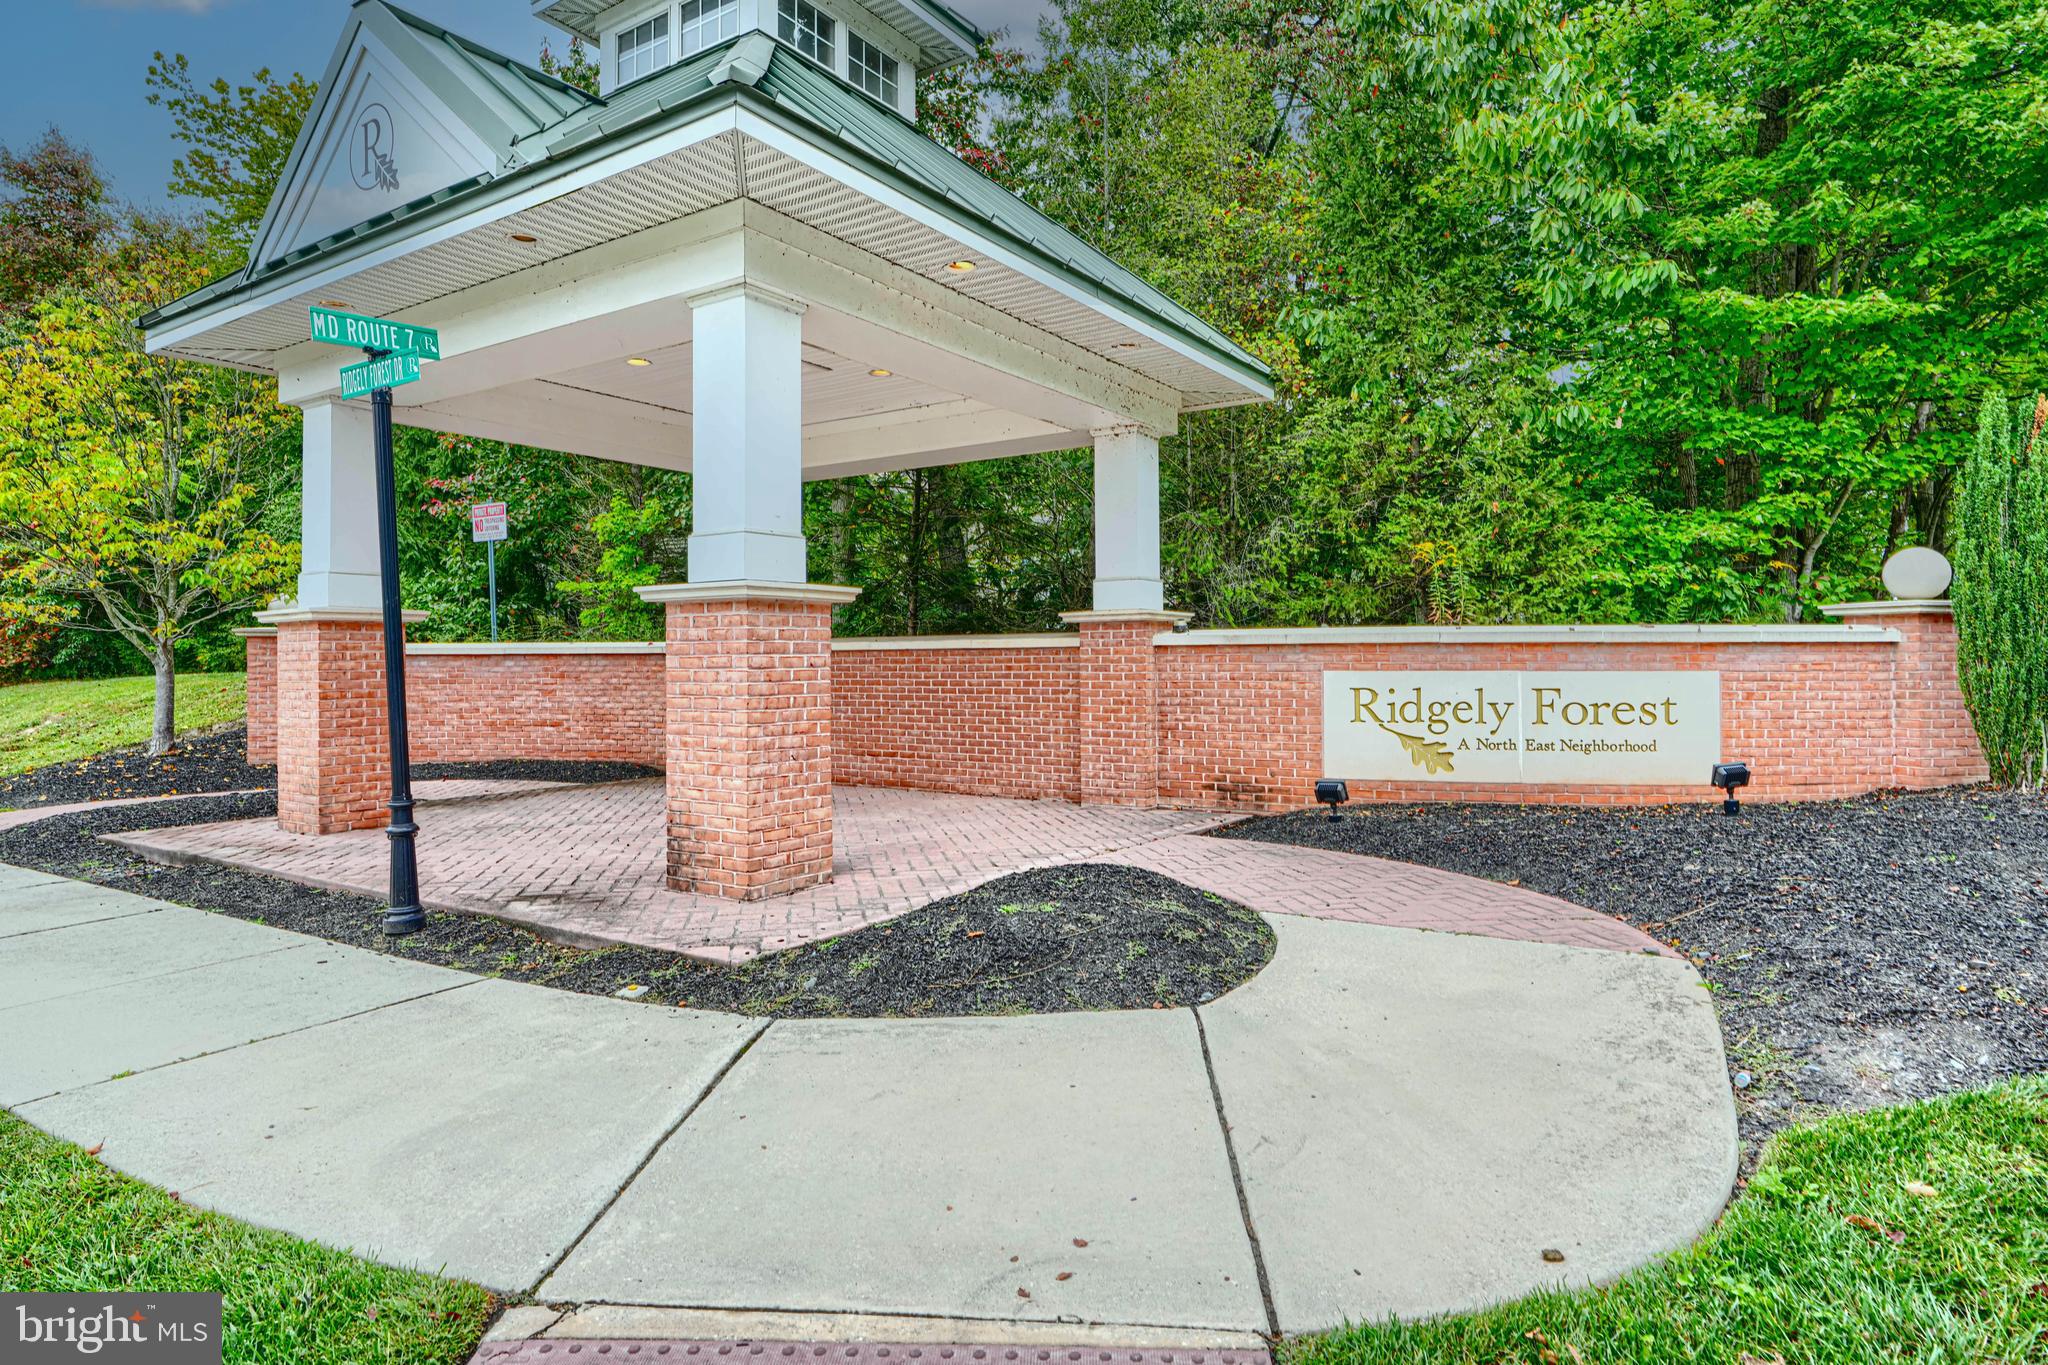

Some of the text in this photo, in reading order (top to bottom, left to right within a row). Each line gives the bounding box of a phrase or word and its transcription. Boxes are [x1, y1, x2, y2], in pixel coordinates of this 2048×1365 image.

[312, 311, 414, 349] MD ROUTE 7
[342, 356, 404, 394] RIDGELY FOREST DR
[475, 519, 483, 532] NO
[1349, 686, 1679, 735] Ridgely Forest
[1457, 738, 1658, 755] A North East Neighborhood
